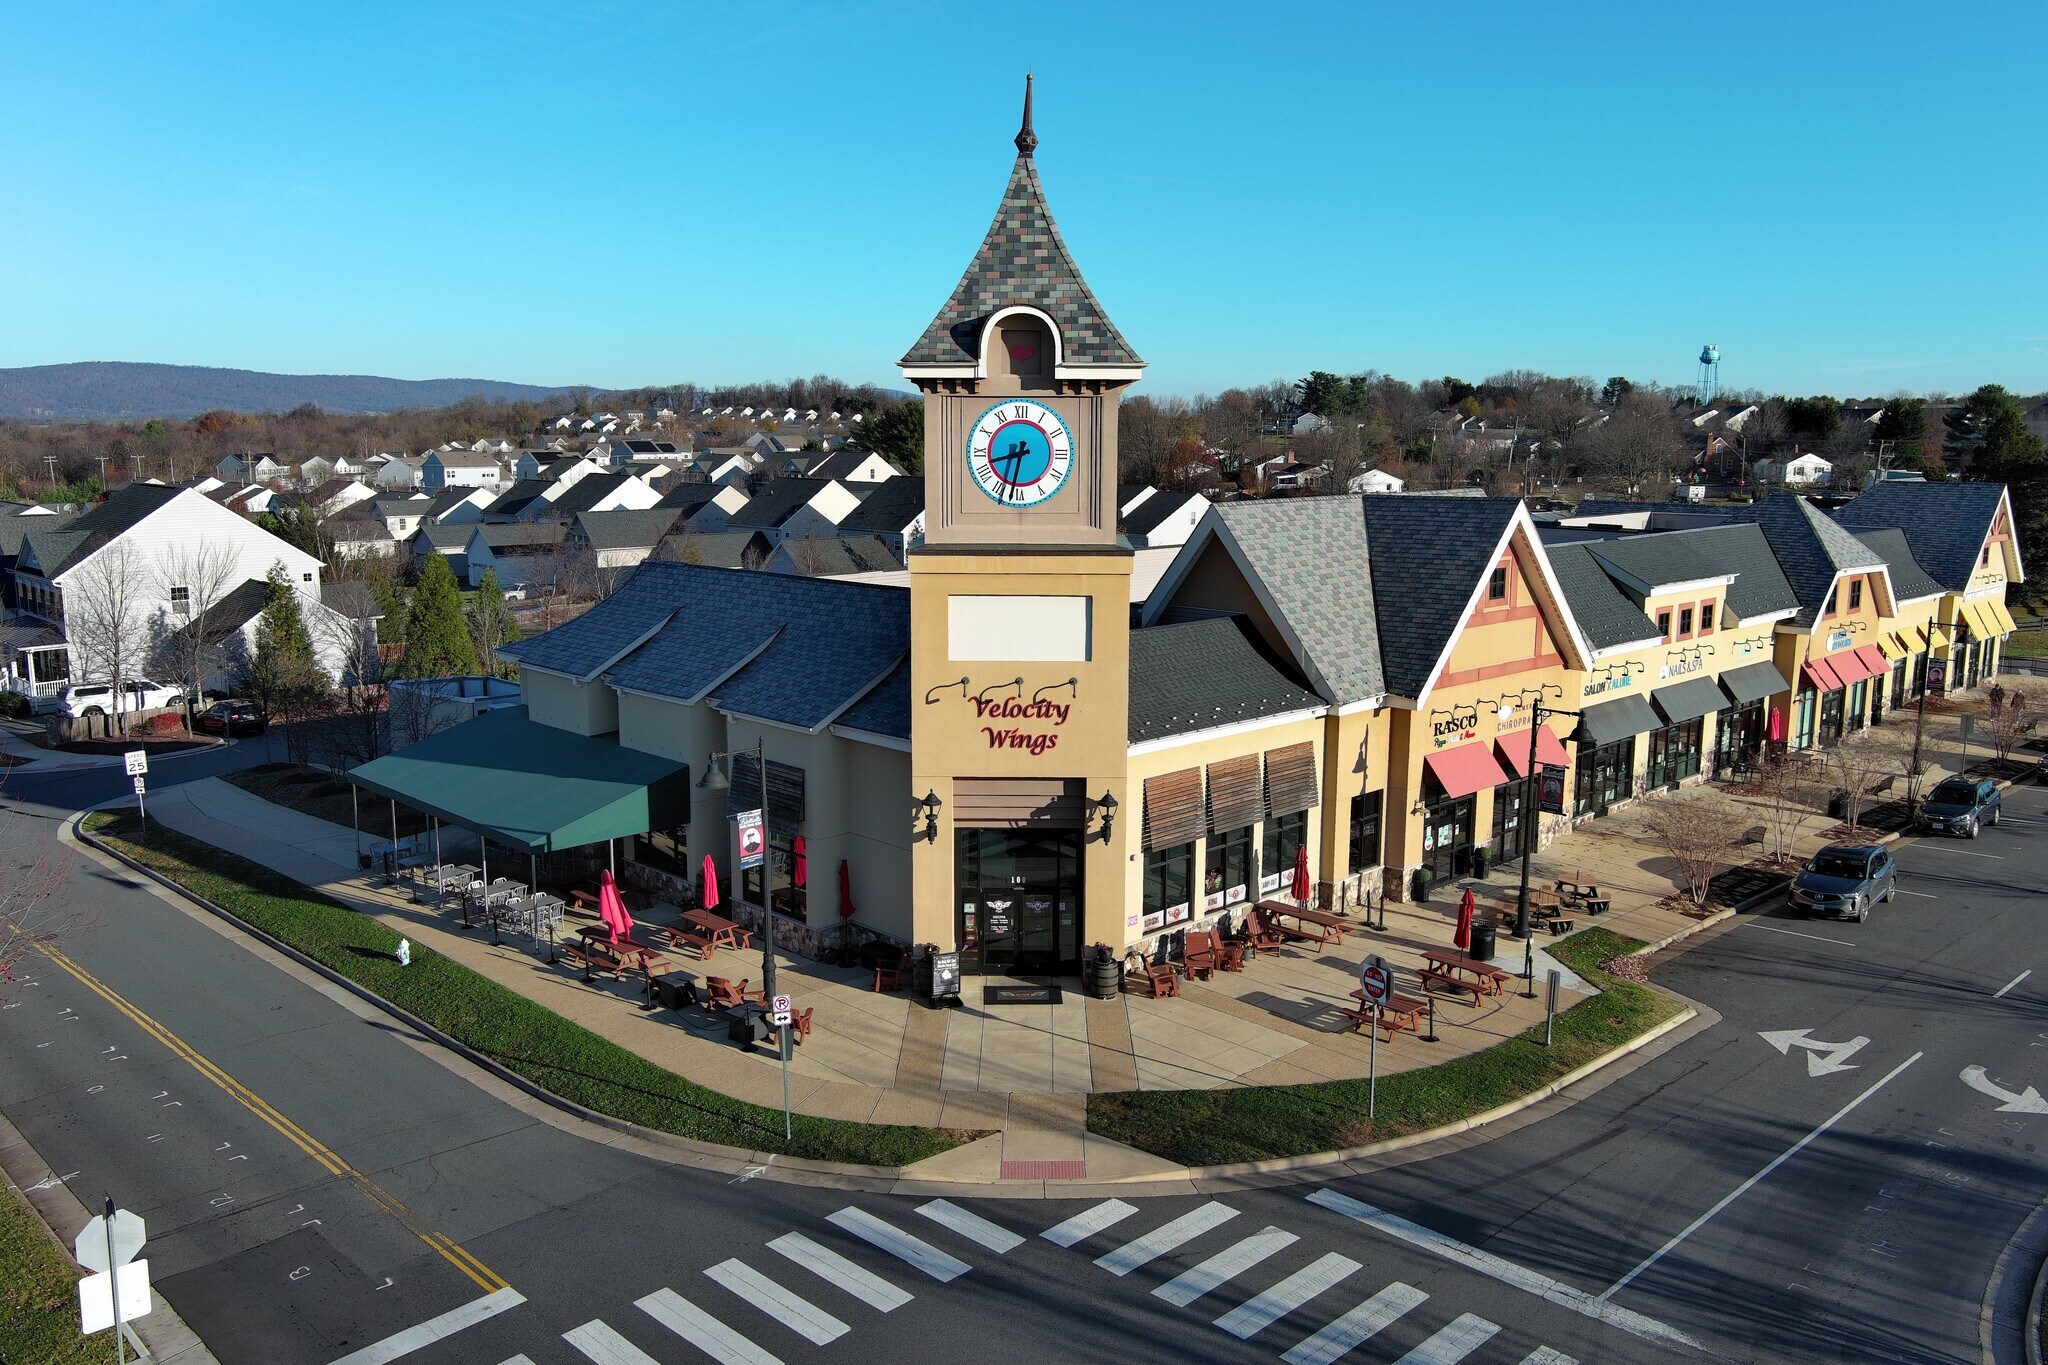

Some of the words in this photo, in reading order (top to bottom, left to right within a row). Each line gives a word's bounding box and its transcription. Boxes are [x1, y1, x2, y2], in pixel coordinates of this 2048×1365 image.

[1584, 682, 1606, 696] SALON
[968, 696, 1071, 726] Velocity
[1433, 714, 1478, 737] RASCO
[980, 727, 1059, 756] Wings
[129, 763, 145, 772] 25
[1368, 984, 1381, 994] ENTER
